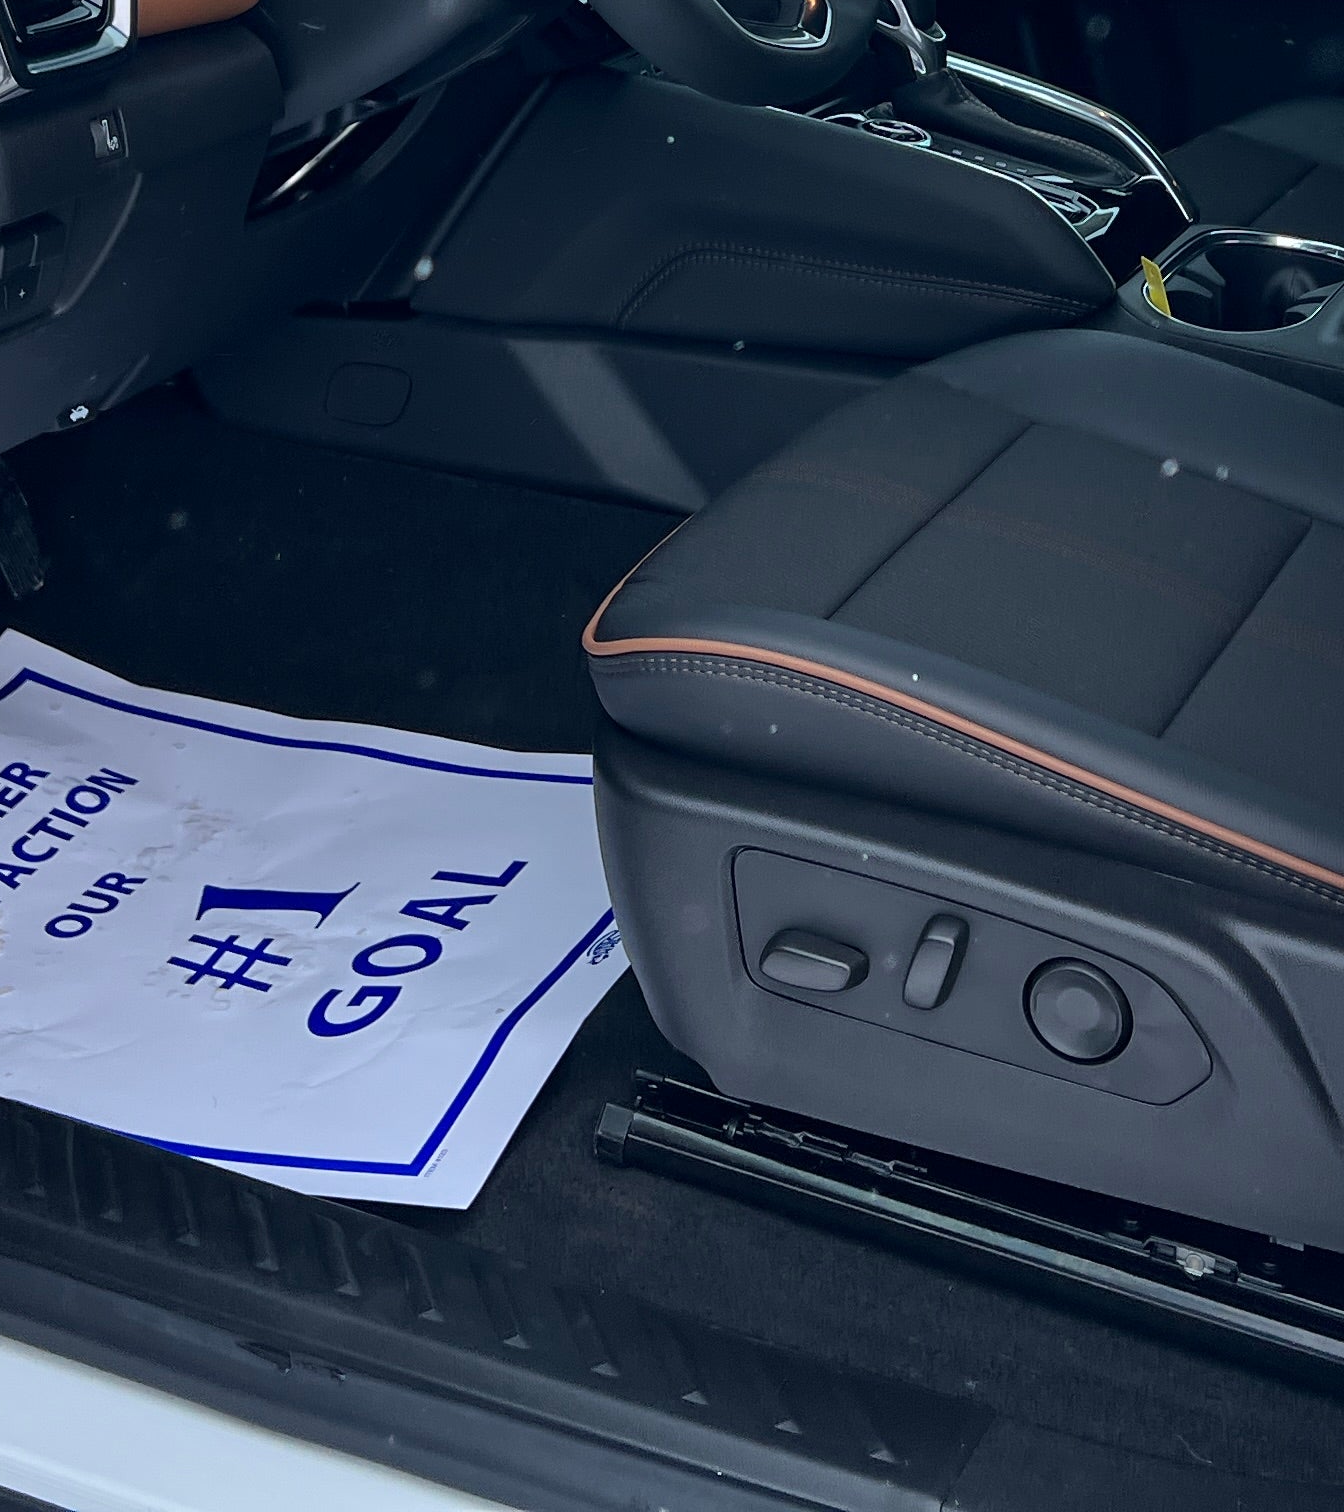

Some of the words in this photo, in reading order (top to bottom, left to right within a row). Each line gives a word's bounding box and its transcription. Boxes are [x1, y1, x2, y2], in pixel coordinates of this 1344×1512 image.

[44, 871, 149, 939] OUR
[166, 882, 361, 993] #1
[307, 860, 529, 1038] GOAL
